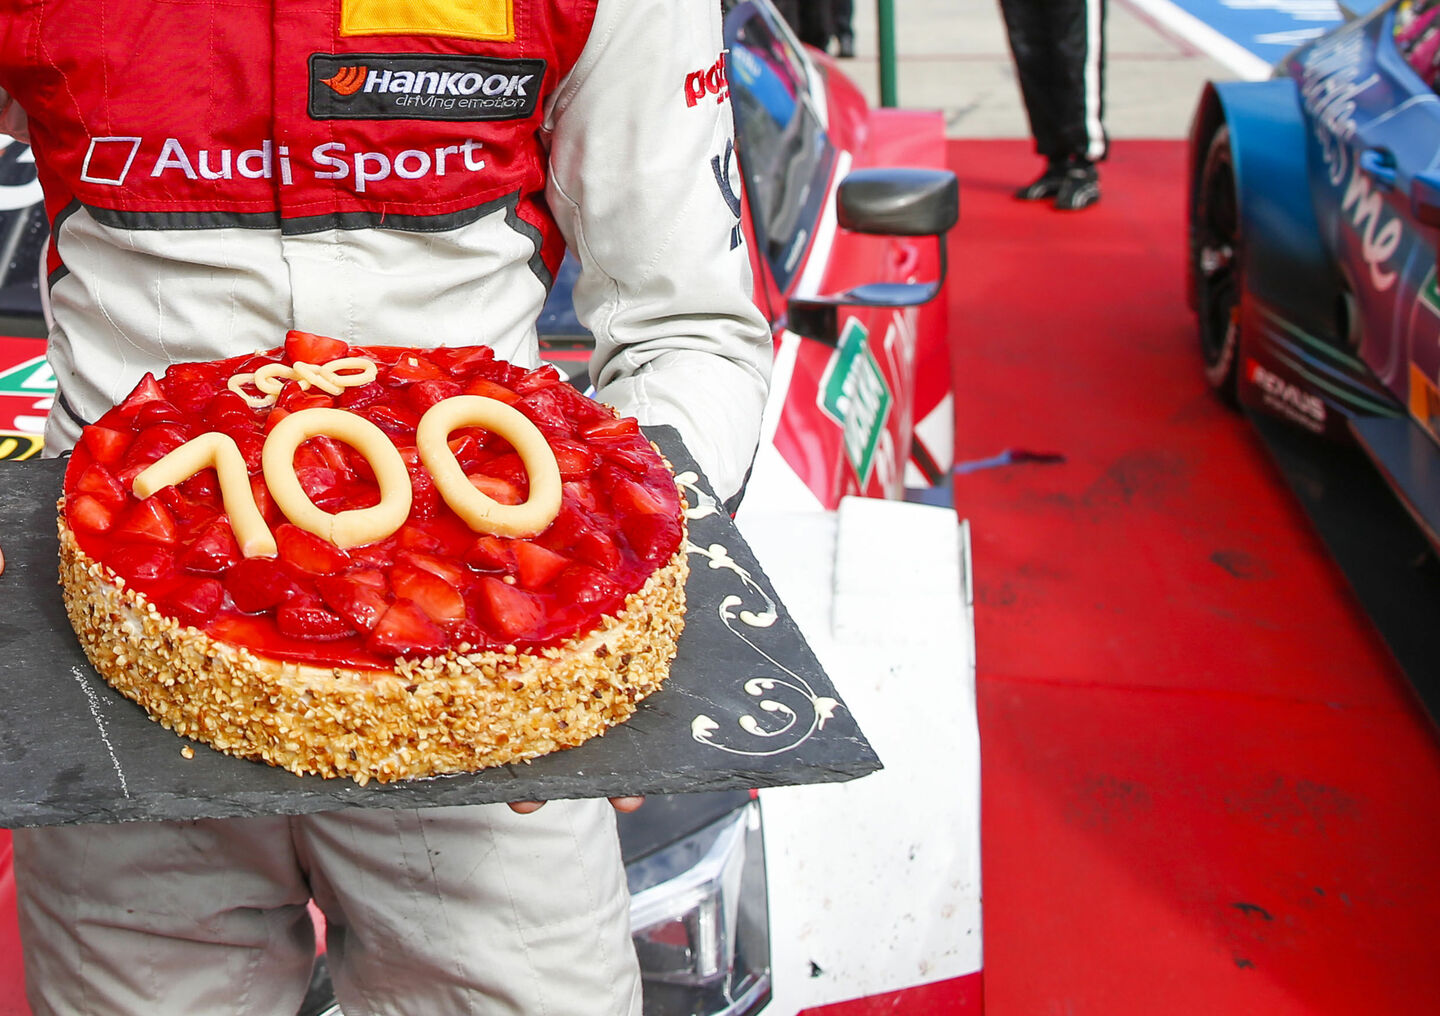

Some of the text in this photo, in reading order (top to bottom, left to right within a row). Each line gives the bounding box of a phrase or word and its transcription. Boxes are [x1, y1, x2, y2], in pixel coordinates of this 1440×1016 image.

[395, 94, 526, 110] driving emotion
[151, 138, 486, 192] Audi Sport
[133, 394, 563, 559] 100
